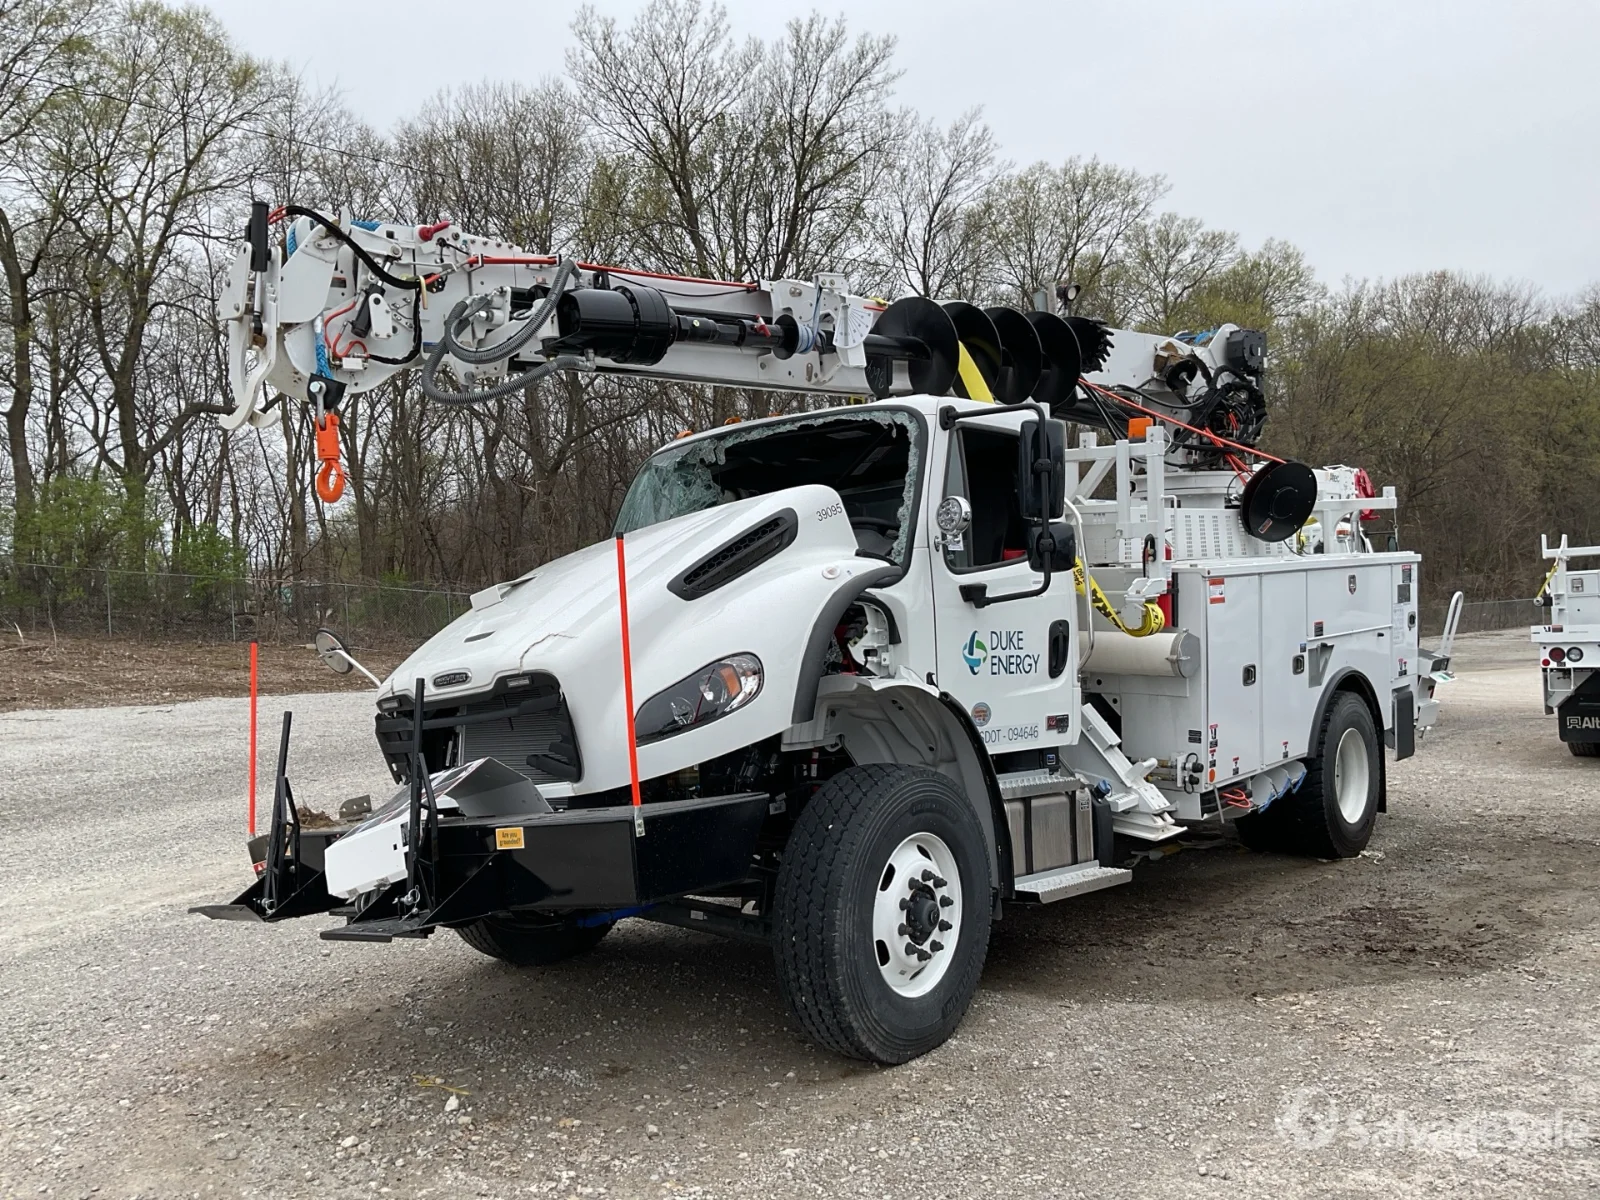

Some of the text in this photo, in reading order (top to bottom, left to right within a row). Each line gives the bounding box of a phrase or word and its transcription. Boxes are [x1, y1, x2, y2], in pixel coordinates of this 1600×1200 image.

[816, 503, 842, 521] 39095
[990, 631, 1024, 651] DUKE
[991, 654, 1040, 675] ENERGY
[1582, 716, 1600, 729] Alt
[1007, 726, 1039, 742] 094646
